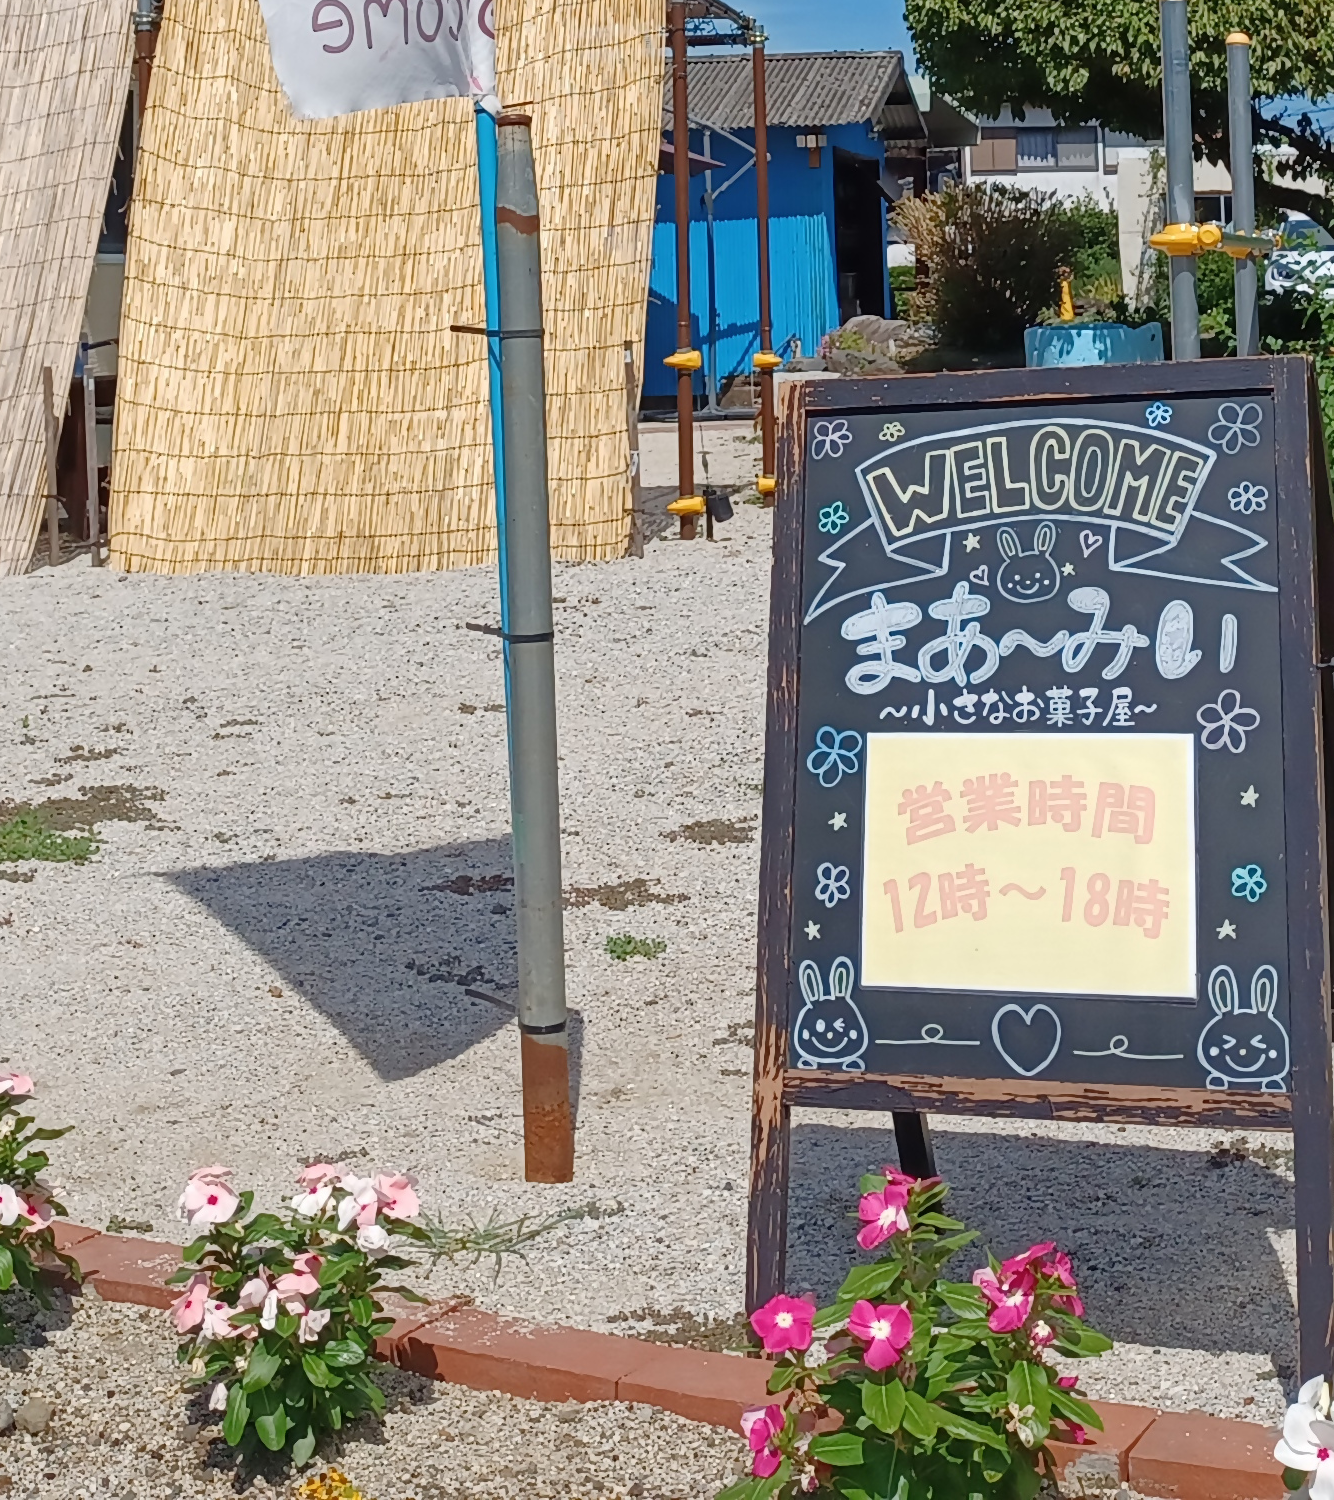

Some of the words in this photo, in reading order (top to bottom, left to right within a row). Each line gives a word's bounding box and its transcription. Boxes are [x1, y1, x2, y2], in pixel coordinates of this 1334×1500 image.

[865, 425, 1207, 538] WELCOME
[896, 771, 1157, 846] 営業時間
